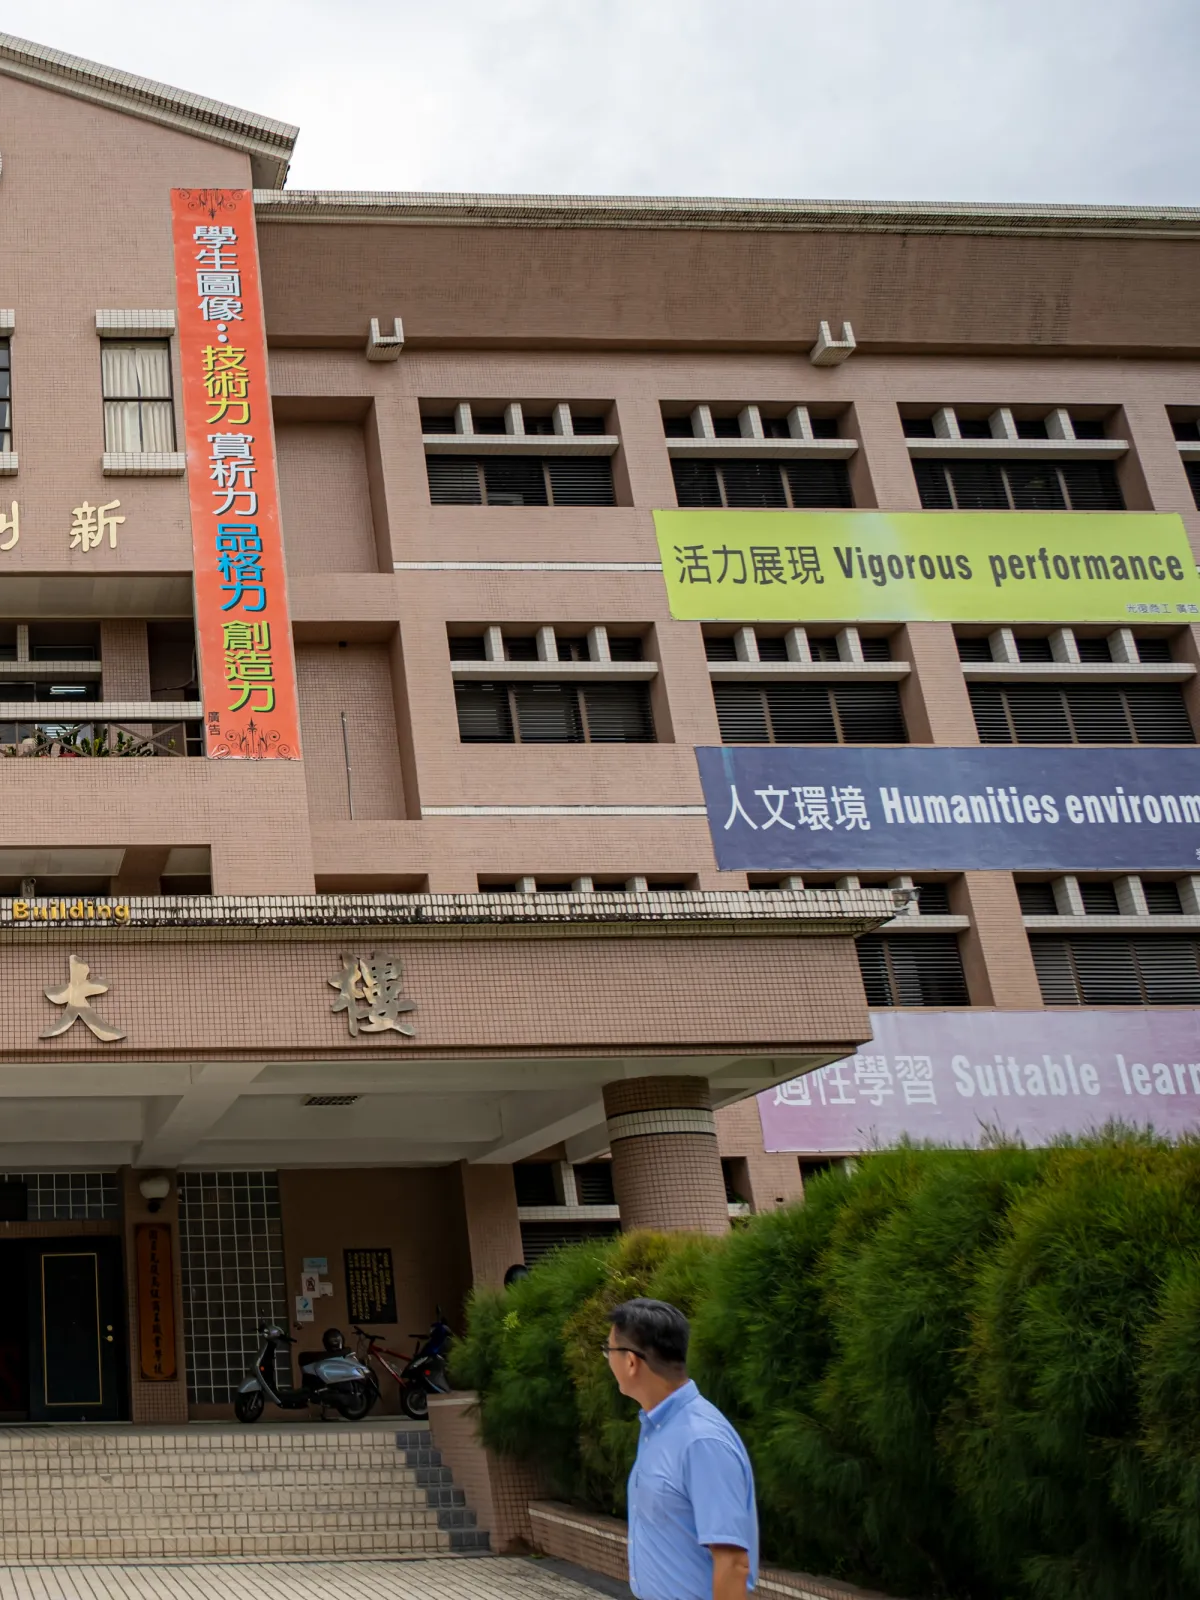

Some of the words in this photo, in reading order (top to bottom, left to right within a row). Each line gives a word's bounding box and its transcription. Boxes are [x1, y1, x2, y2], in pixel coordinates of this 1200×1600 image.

[207, 433, 258, 516] 賞析力
[215, 523, 267, 612] 品格力
[673, 544, 825, 585] 活力展現
[832, 546, 973, 587] Vigorous
[988, 547, 1185, 587] performance
[220, 619, 275, 712] 創造力
[208, 711, 221, 736] 廣告
[724, 785, 871, 832] 人文環境
[879, 786, 1060, 825] Humanities
[12, 899, 131, 925] Building
[951, 1054, 1100, 1098] Suitable
